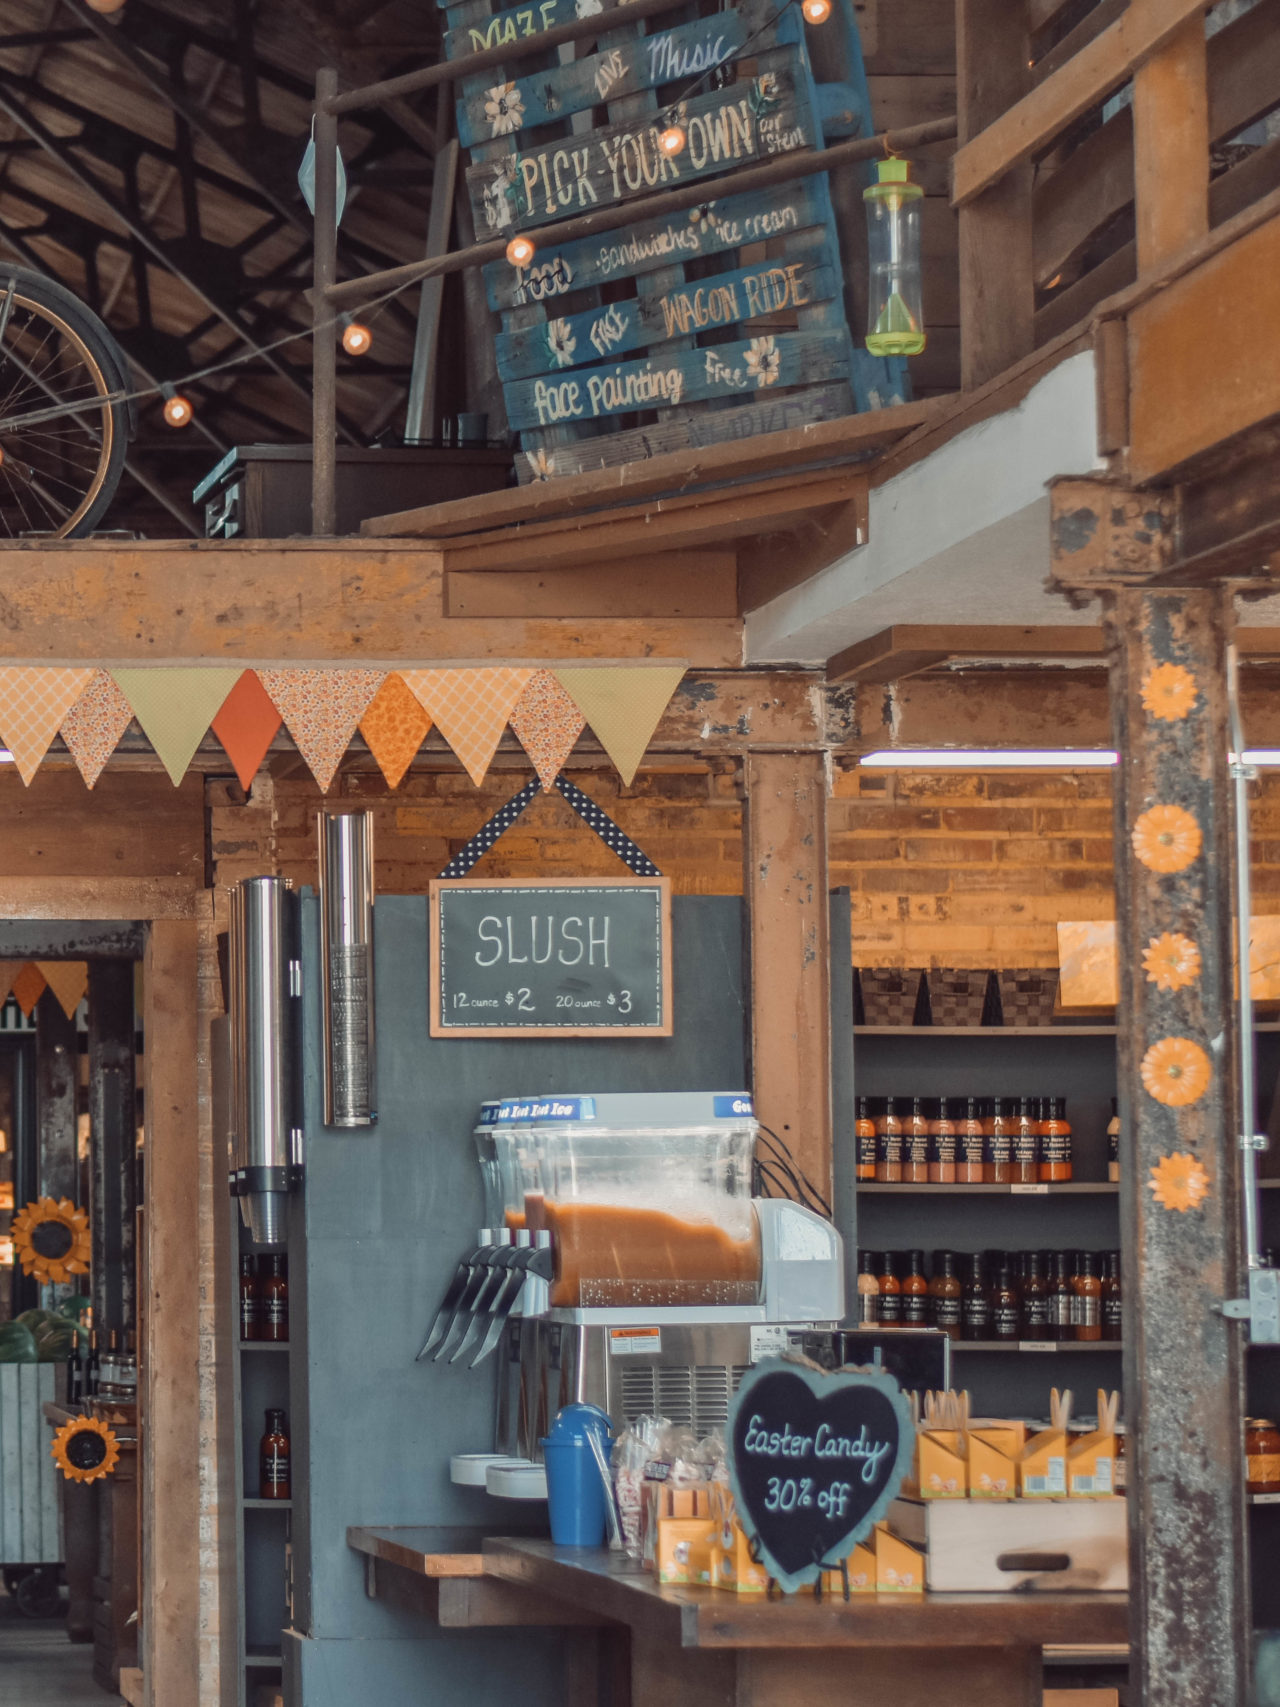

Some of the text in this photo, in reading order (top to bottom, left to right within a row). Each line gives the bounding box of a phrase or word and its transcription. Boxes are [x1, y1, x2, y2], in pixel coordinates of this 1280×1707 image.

[468, 0, 557, 51] MAZE
[594, 33, 738, 100] LIVE Music
[688, 100, 753, 170] OWN
[744, 206, 798, 239] cream
[660, 283, 740, 338] WAGON
[742, 263, 810, 319] RIDE
[704, 350, 748, 388] Free
[475, 916, 610, 967] SLUSH
[453, 992, 470, 1008] 12
[471, 997, 499, 1008] ounce
[556, 995, 573, 1008] 20
[575, 998, 602, 1008] ounce
[745, 1415, 890, 1482] Easter Candy
[765, 1477, 852, 1518] 30% off
